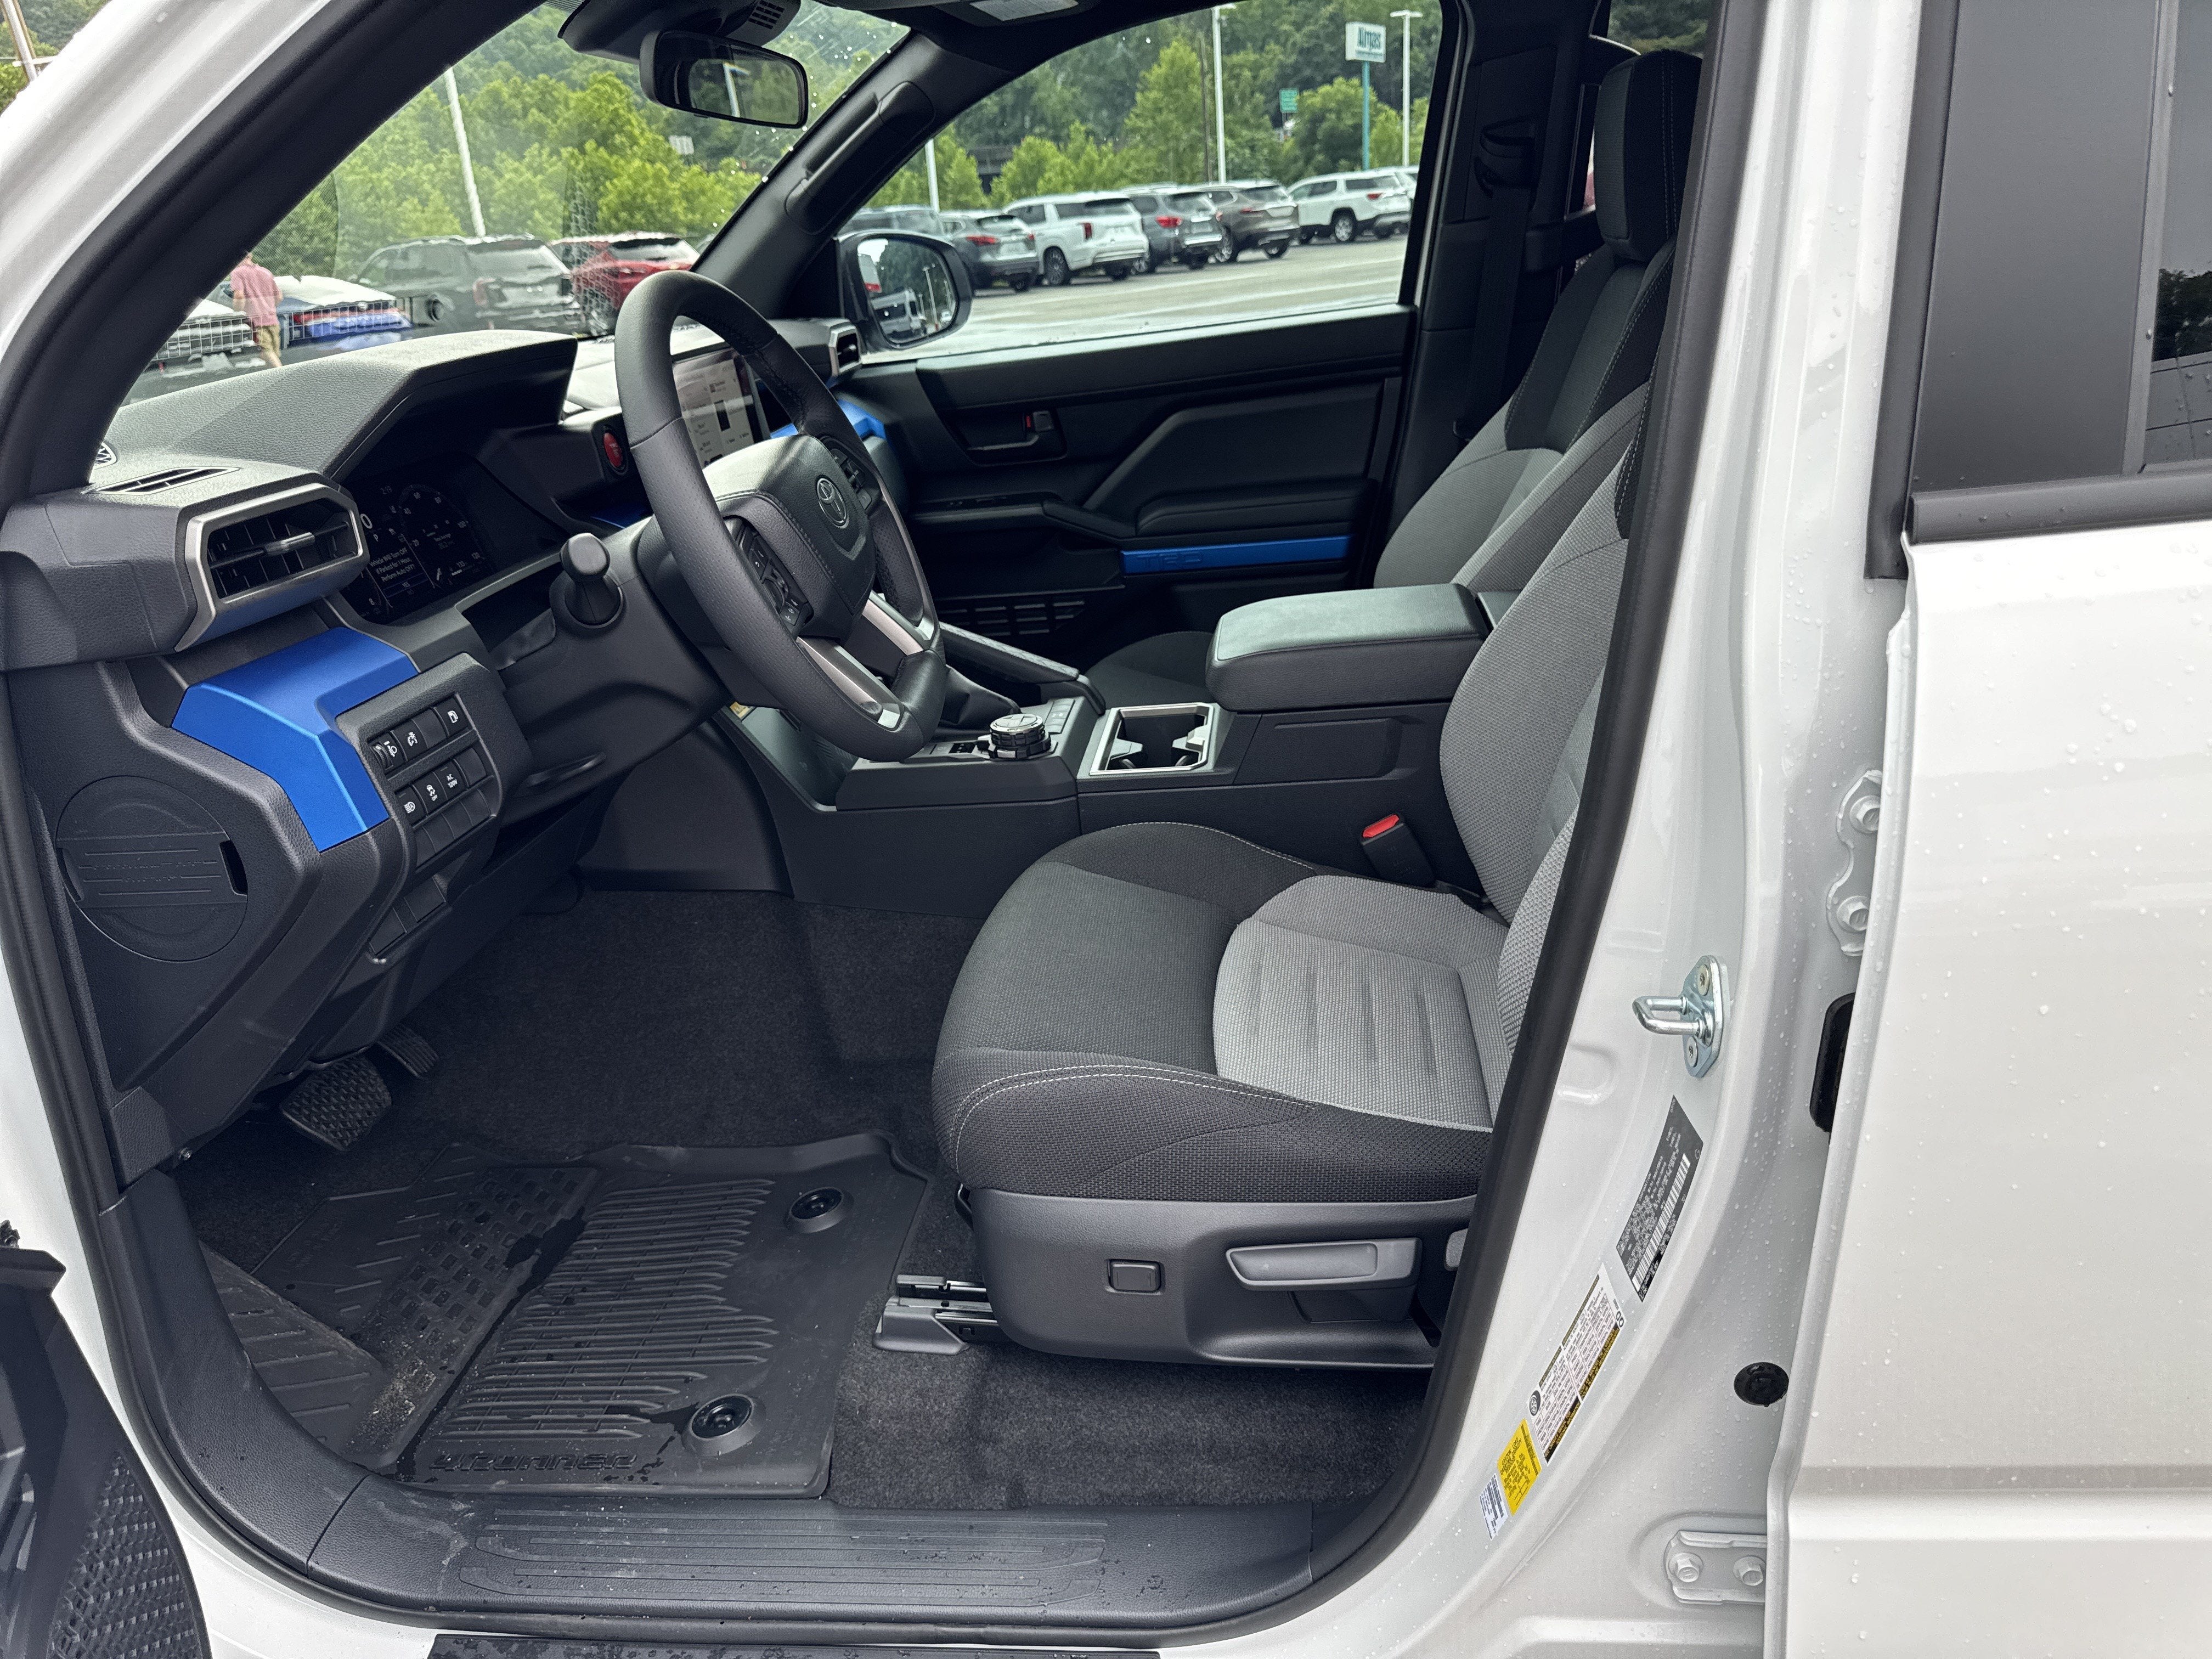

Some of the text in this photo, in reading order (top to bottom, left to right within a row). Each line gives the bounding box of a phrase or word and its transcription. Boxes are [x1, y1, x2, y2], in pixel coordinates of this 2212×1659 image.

[360, 514, 373, 529] 0
[373, 534, 379, 542] P
[379, 564, 393, 573] Parked
[447, 779, 458, 788] 120V
